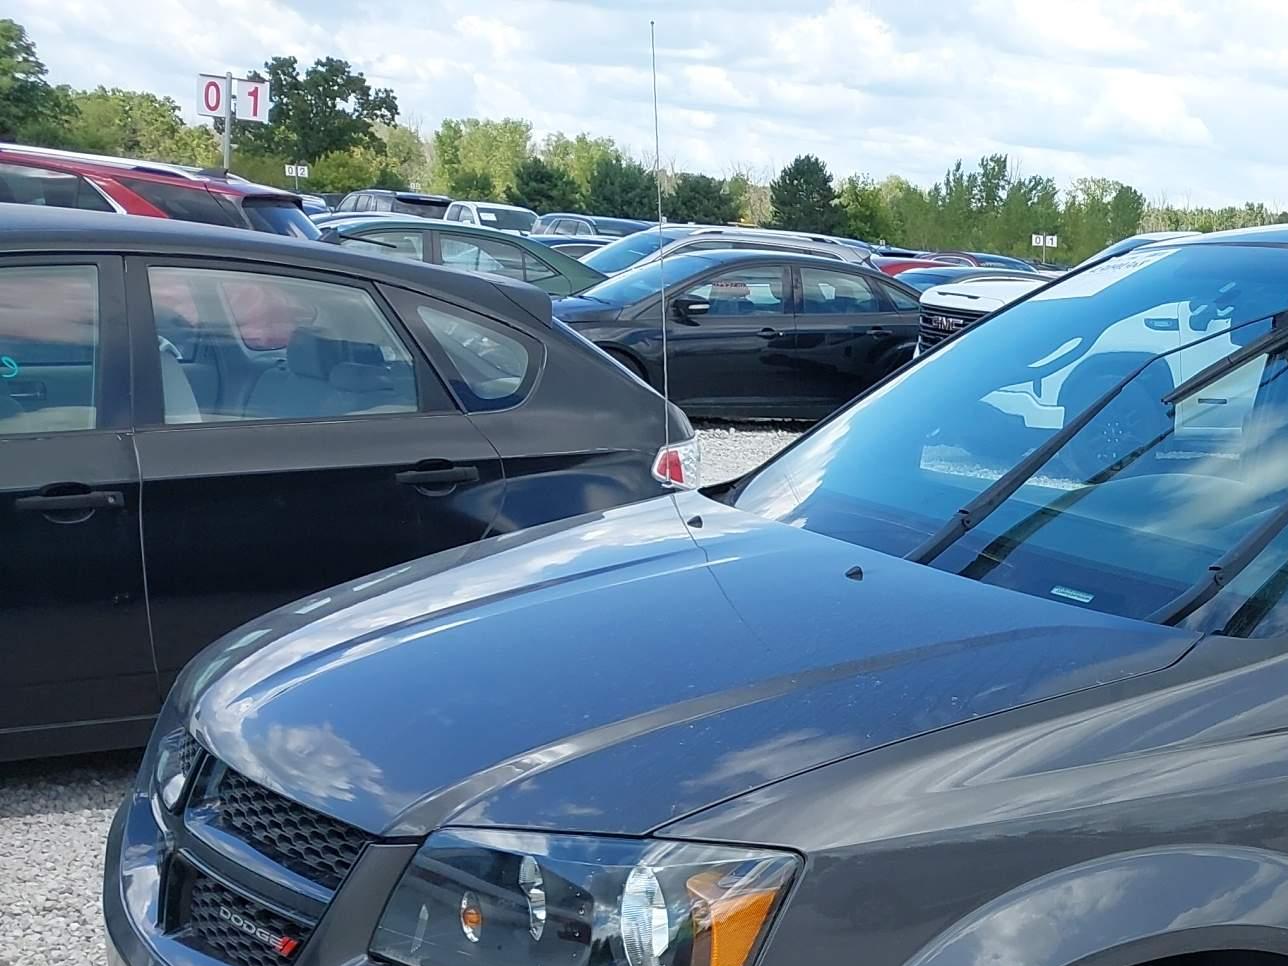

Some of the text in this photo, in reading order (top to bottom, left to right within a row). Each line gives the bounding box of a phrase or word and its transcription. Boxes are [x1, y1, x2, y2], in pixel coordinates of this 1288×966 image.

[204, 80, 259, 117] 0 1
[932, 316, 963, 330] GMC
[220, 906, 284, 950] DODGE
